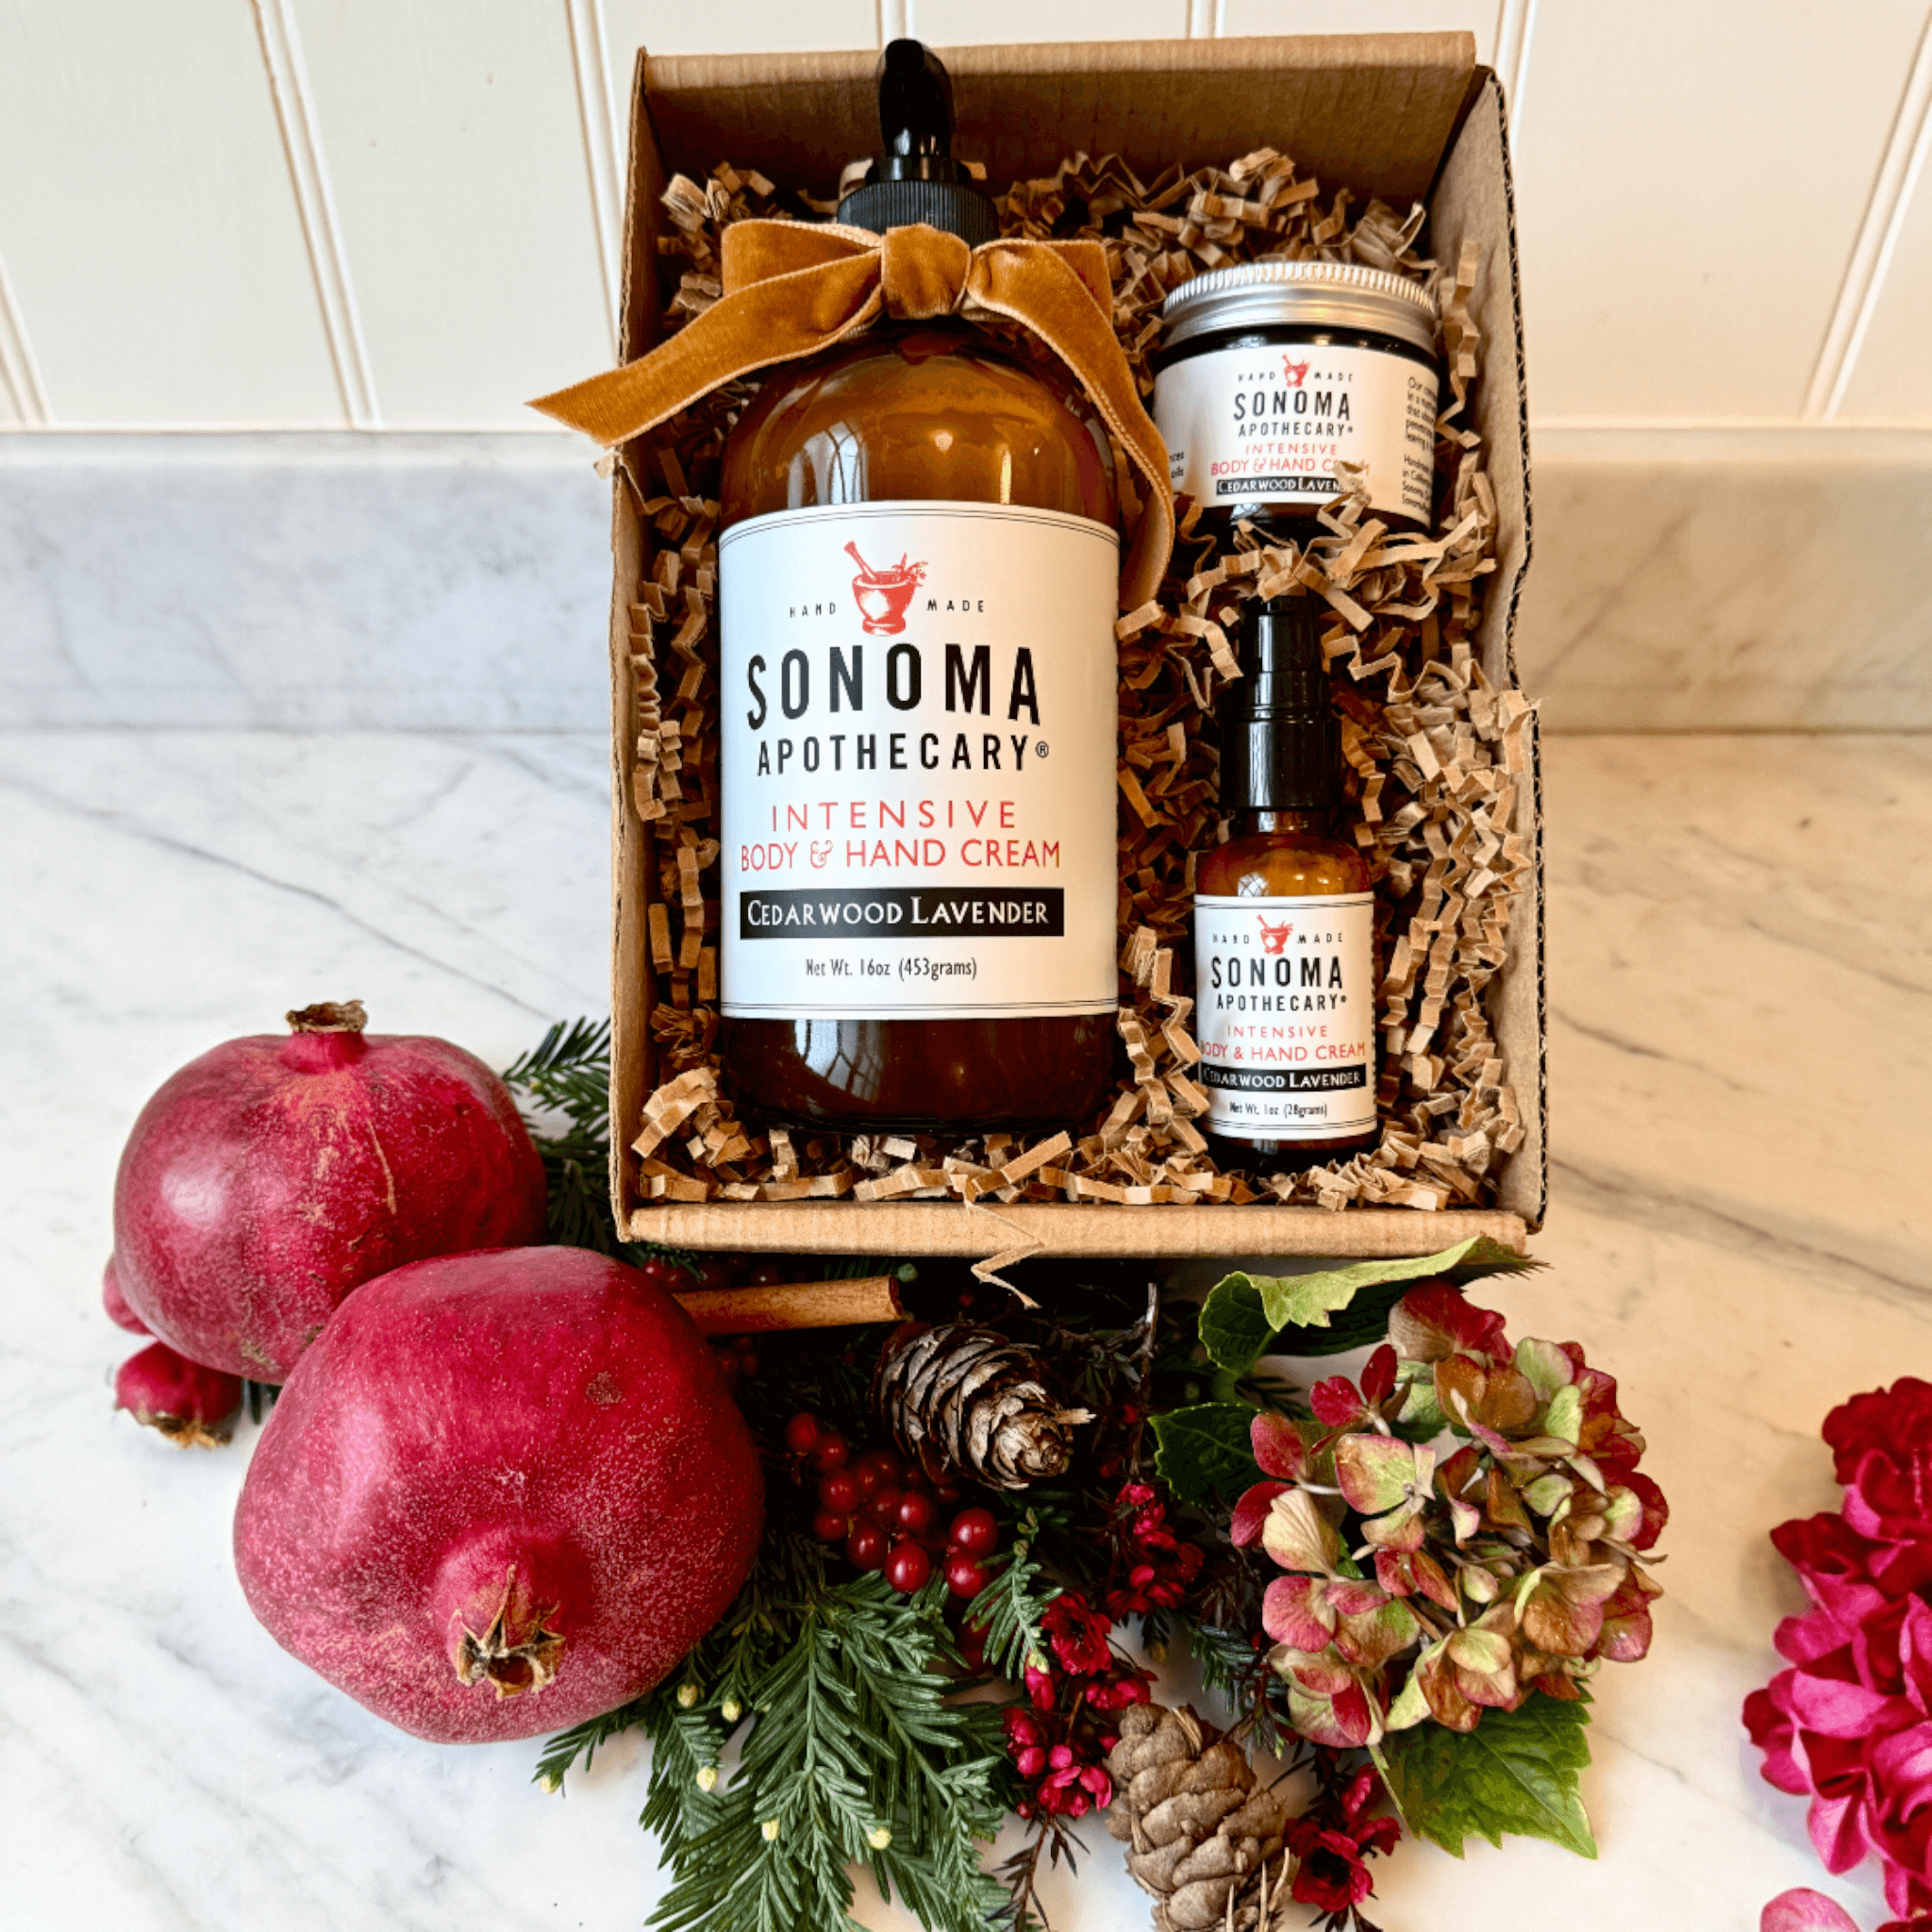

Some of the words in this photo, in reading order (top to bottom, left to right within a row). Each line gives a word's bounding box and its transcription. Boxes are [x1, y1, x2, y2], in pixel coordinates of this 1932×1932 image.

[1233, 390, 1350, 422] SONOMA
[1245, 442, 1338, 456] INTENSIVE
[1210, 458, 1250, 476] BODY
[1252, 458, 1266, 473] &
[1269, 458, 1316, 473] HAND
[790, 602, 836, 618] HAND
[926, 598, 985, 613] MADE
[746, 642, 1041, 731] SONOMA
[772, 799, 1015, 832] INTENSIVE
[741, 841, 799, 872] BODY
[809, 839, 834, 870] &
[846, 839, 946, 868] HAND
[960, 838, 1060, 869] CREAM
[747, 899, 903, 926] CEDARWOOD
[909, 895, 1050, 925] LAVENDER
[1296, 932, 1343, 944] MADE
[806, 958, 826, 976] Net
[829, 958, 854, 976] Wt.
[859, 958, 891, 976] 16oz
[898, 957, 977, 981] (453grams)
[1210, 956, 1343, 989] SONOMA
[1227, 1024, 1328, 1039] INTENSIVE
[1233, 1045, 1244, 1060] &
[1250, 1045, 1308, 1062] HAND
[1315, 1041, 1366, 1060] CREAM
[1289, 1070, 1361, 1089] LAVENDER
